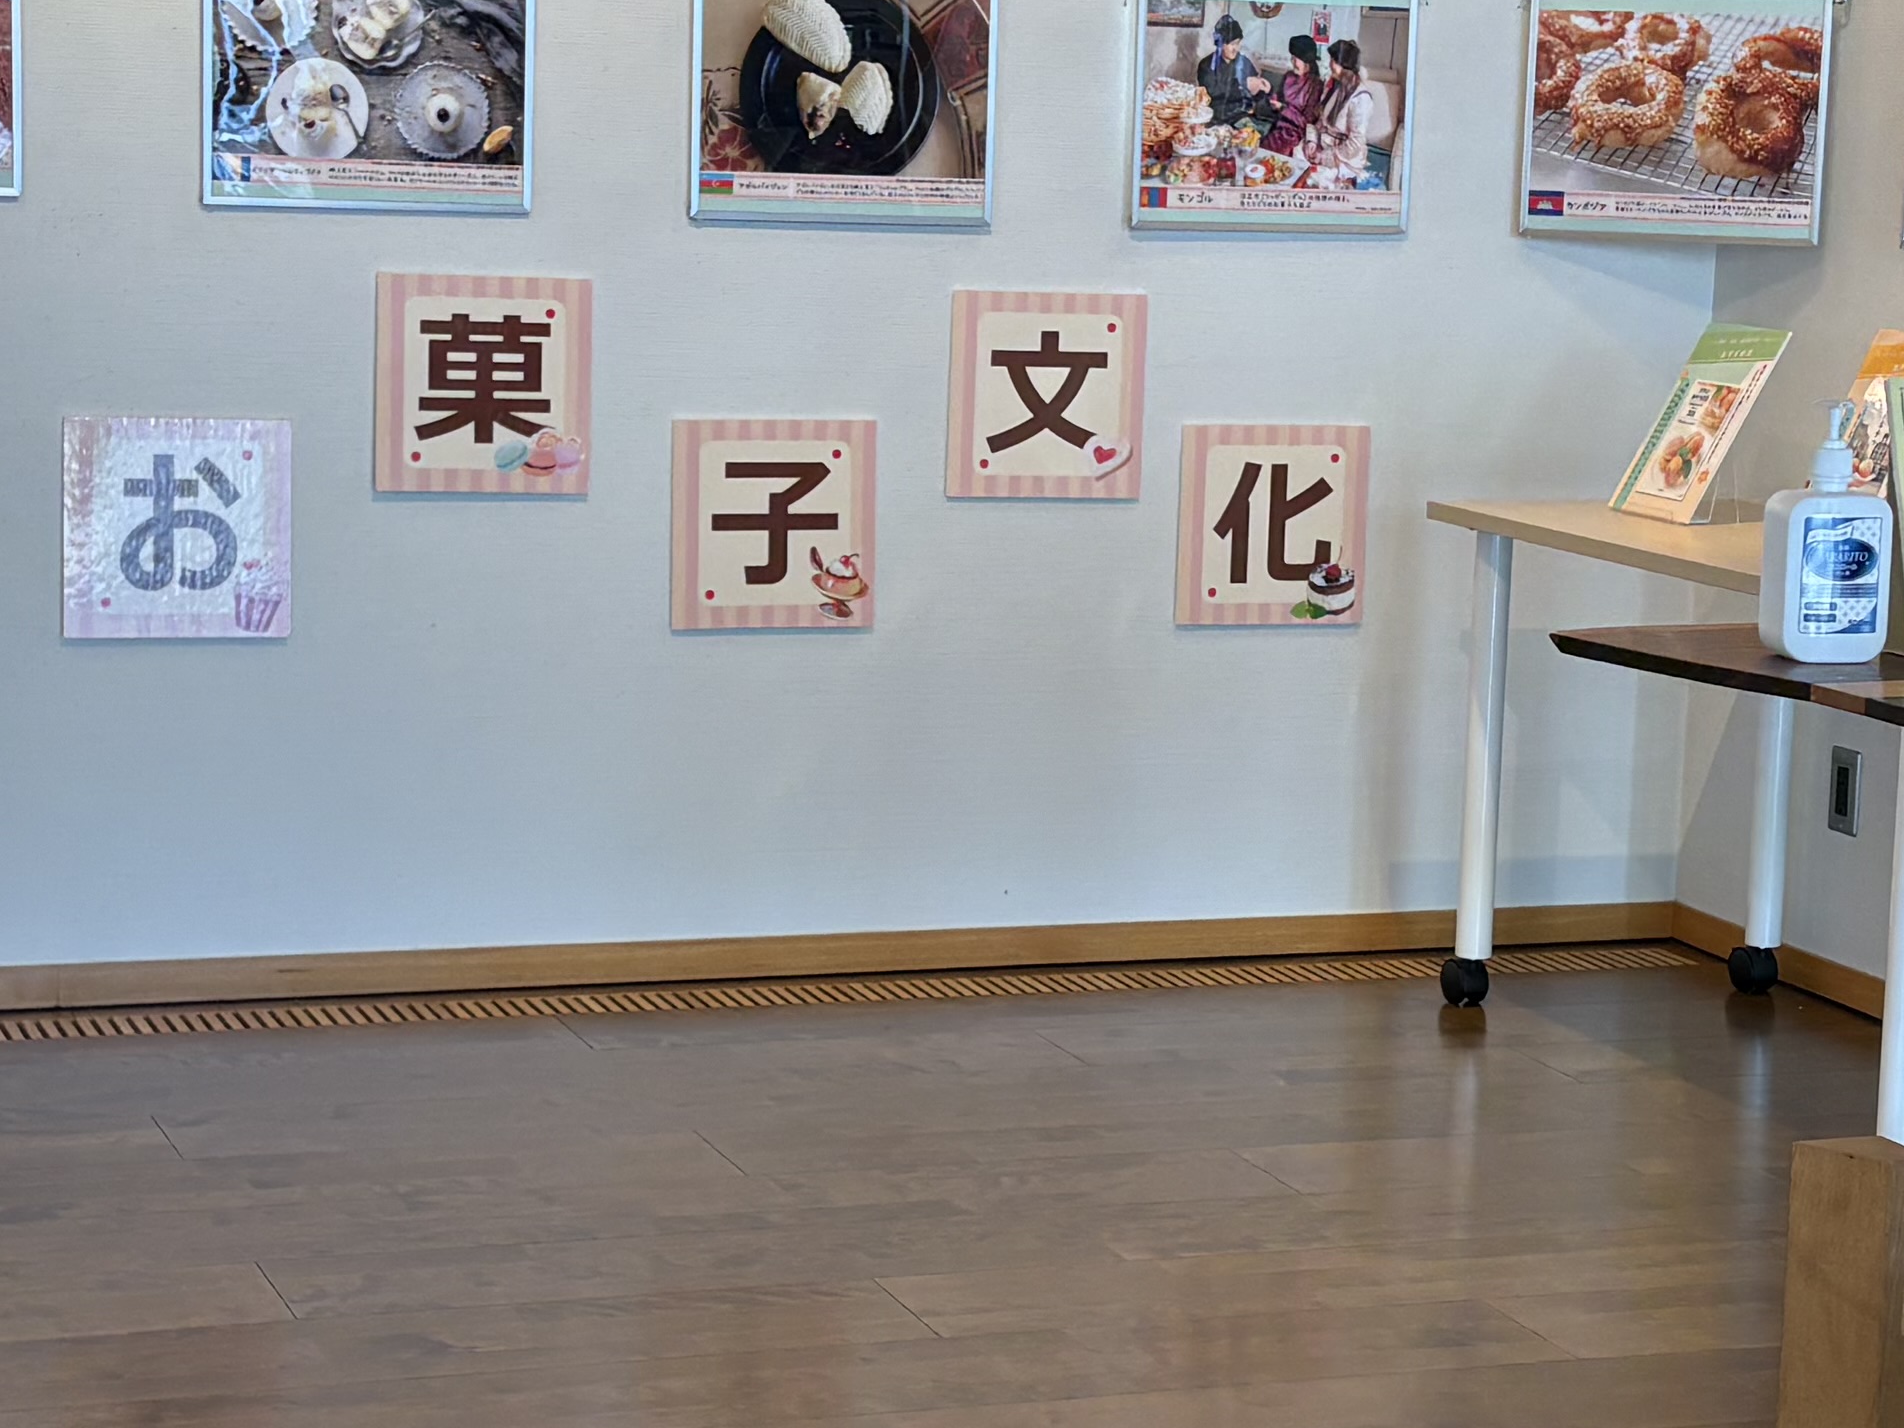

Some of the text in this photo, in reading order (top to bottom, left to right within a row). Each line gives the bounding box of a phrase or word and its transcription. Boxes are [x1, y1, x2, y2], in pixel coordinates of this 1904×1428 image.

[1177, 191, 1214, 204] モンゴル
[413, 312, 558, 445] 菓
[985, 330, 1110, 455] 文
[118, 453, 242, 593] お
[710, 462, 840, 586] 子
[1212, 462, 1334, 584] 化
